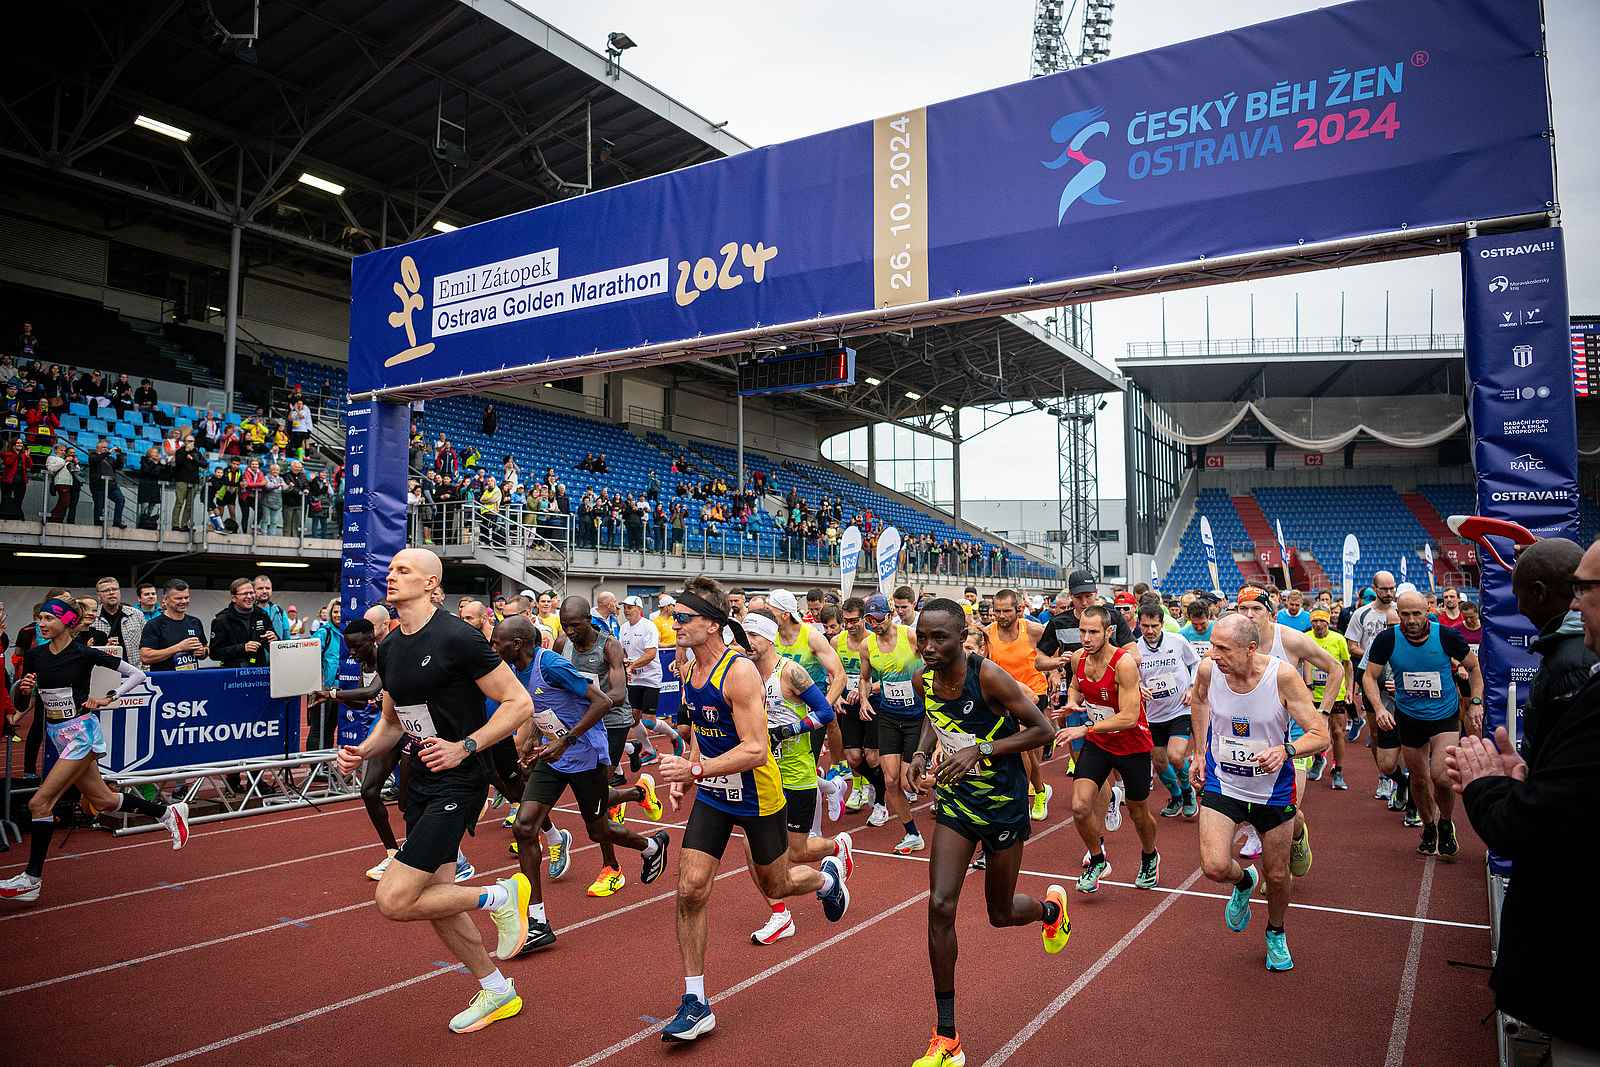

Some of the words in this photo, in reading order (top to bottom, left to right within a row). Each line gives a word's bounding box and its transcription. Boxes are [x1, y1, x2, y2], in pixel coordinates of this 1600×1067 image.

[1127, 92, 1240, 145] ČESKÝ
[1245, 80, 1317, 122] BĚH
[1325, 62, 1404, 107] ŽEN
[1127, 125, 1283, 180] OSTRAVA
[1293, 102, 1401, 150] 2024
[889, 115, 910, 188] 2024
[890, 192, 911, 237] 10.
[1480, 241, 1554, 258] OSTRAVA!!!
[439, 275, 476, 299] Emil
[482, 257, 552, 291] Zátopek
[674, 241, 778, 307] 2024
[890, 243, 911, 289] 26.
[437, 305, 497, 330] Ostrava
[503, 292, 564, 318] Golden
[571, 271, 661, 304] Marathon
[1207, 457, 1223, 467] C1
[1306, 456, 1322, 465] C2
[1491, 490, 1568, 502] OSTRAVA!!!
[1140, 658, 1176, 669] FINISHER
[1155, 680, 1167, 690] 29
[1412, 679, 1433, 688] 275
[890, 688, 905, 697] 121
[119, 698, 144, 706] OVICE
[161, 699, 209, 720] SSK
[161, 719, 280, 746] VÍTKOVICE
[401, 719, 423, 733] 106
